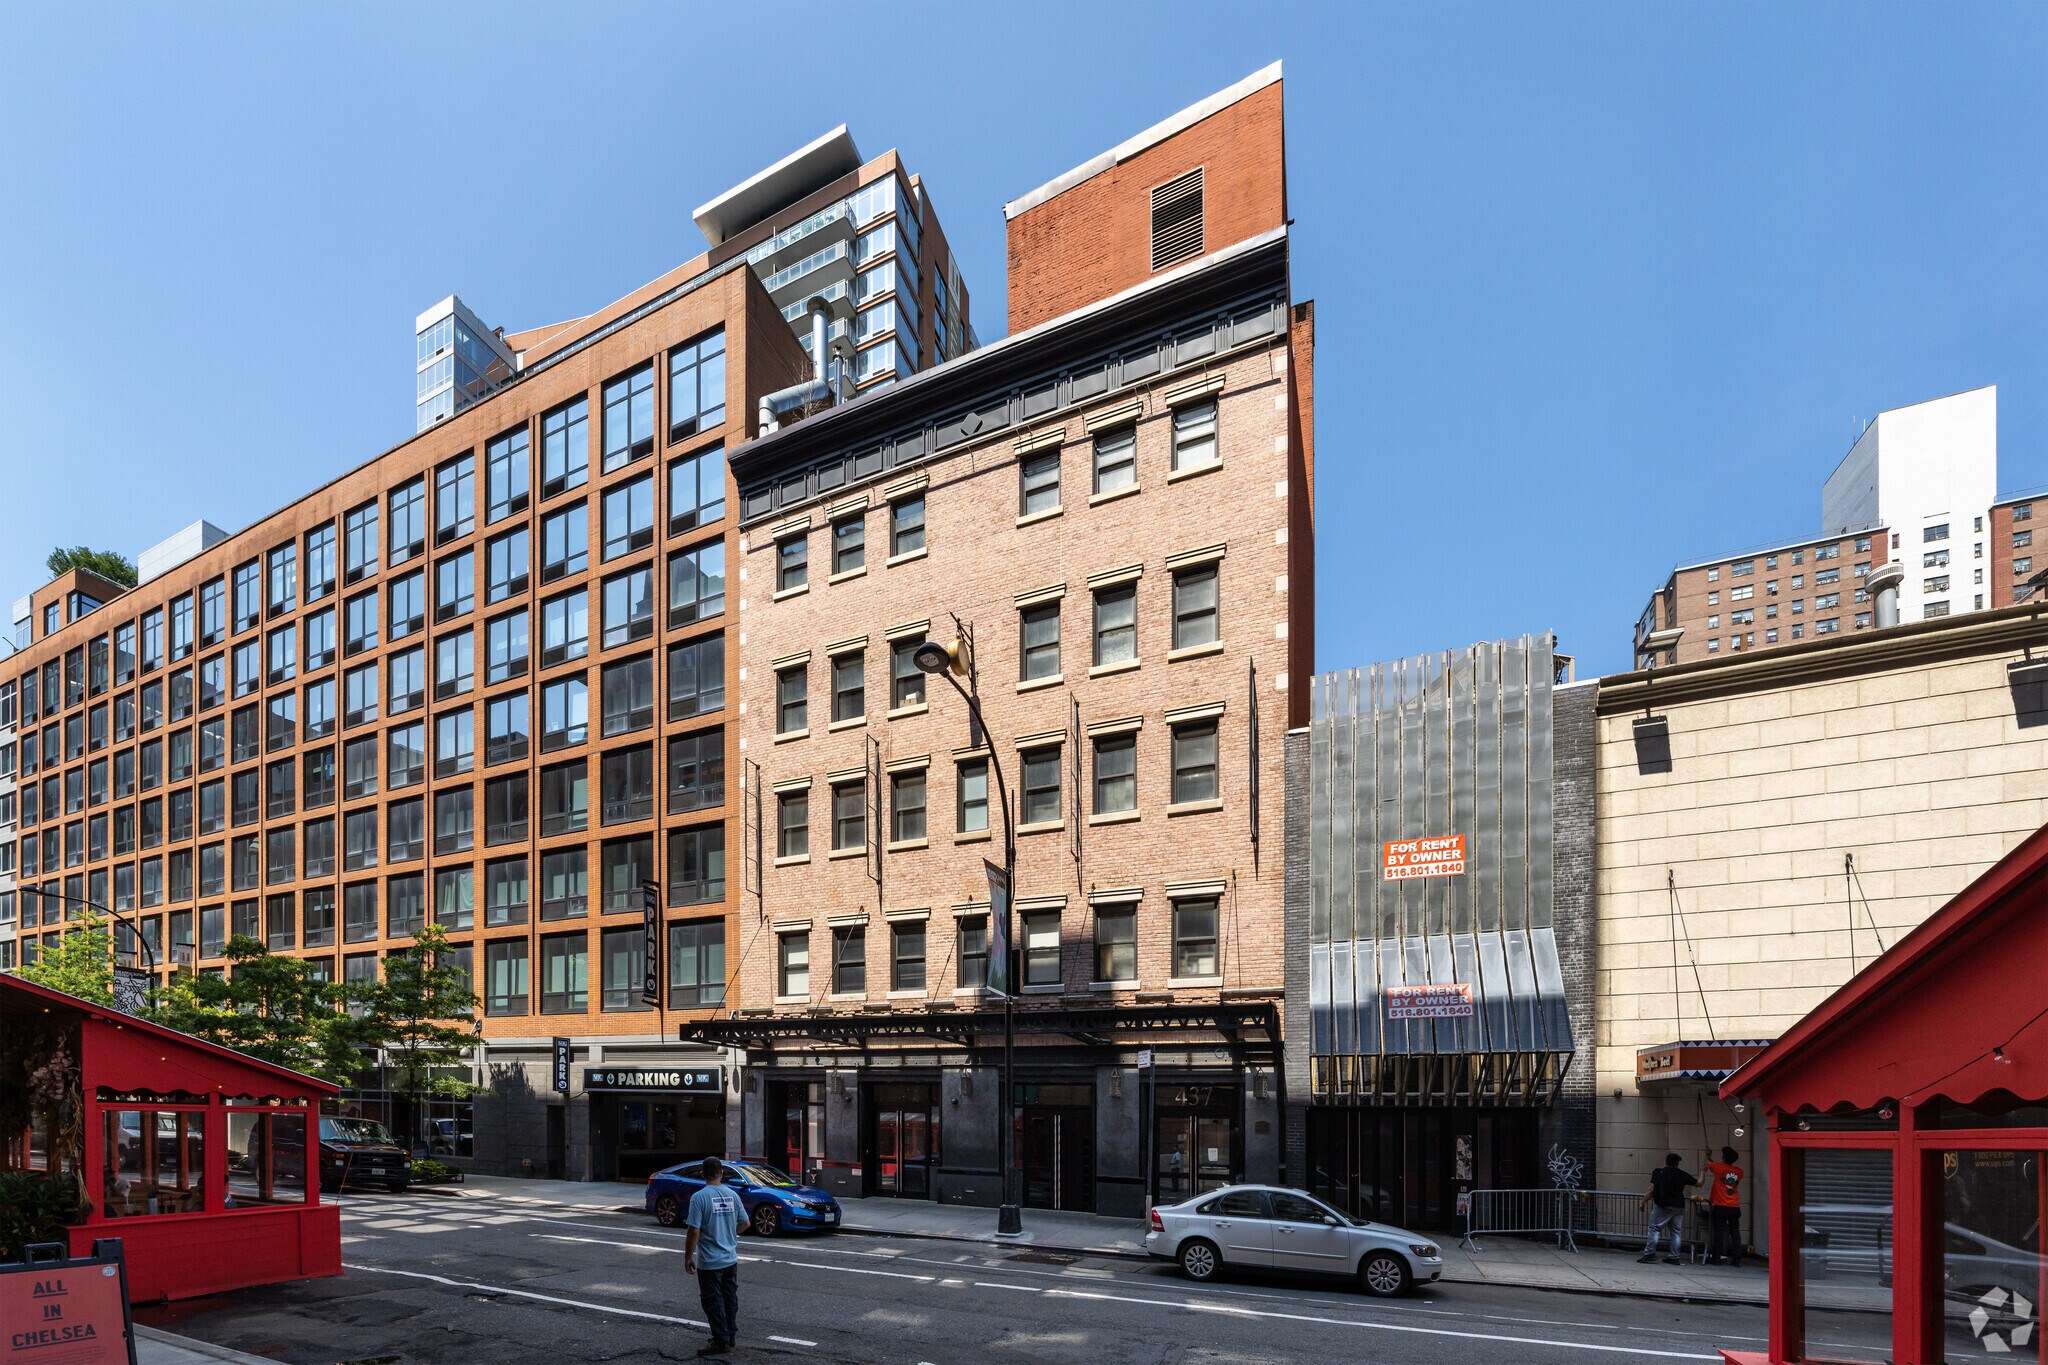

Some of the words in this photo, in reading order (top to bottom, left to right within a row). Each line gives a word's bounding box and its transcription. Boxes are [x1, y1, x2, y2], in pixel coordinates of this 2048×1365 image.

[1390, 842, 1417, 854] FOR
[1421, 837, 1459, 851] RENT
[1387, 854, 1406, 866] BY
[1410, 849, 1461, 863] OWNER
[1386, 863, 1462, 877] 516.801.1840
[646, 906, 656, 976] PARK
[1393, 988, 1422, 998] FOR
[1426, 986, 1466, 996] RENT
[1391, 998, 1411, 1007] BY
[1415, 995, 1469, 1006] OWNER
[1391, 1006, 1471, 1017] 516.801.1840
[558, 1047, 567, 1080] PARK
[617, 1072, 681, 1086] PARKING
[1174, 1086, 1213, 1106] 437
[33, 1280, 68, 1294] ALL
[43, 1303, 61, 1318] IN
[11, 1323, 97, 1347] CHELSEA
